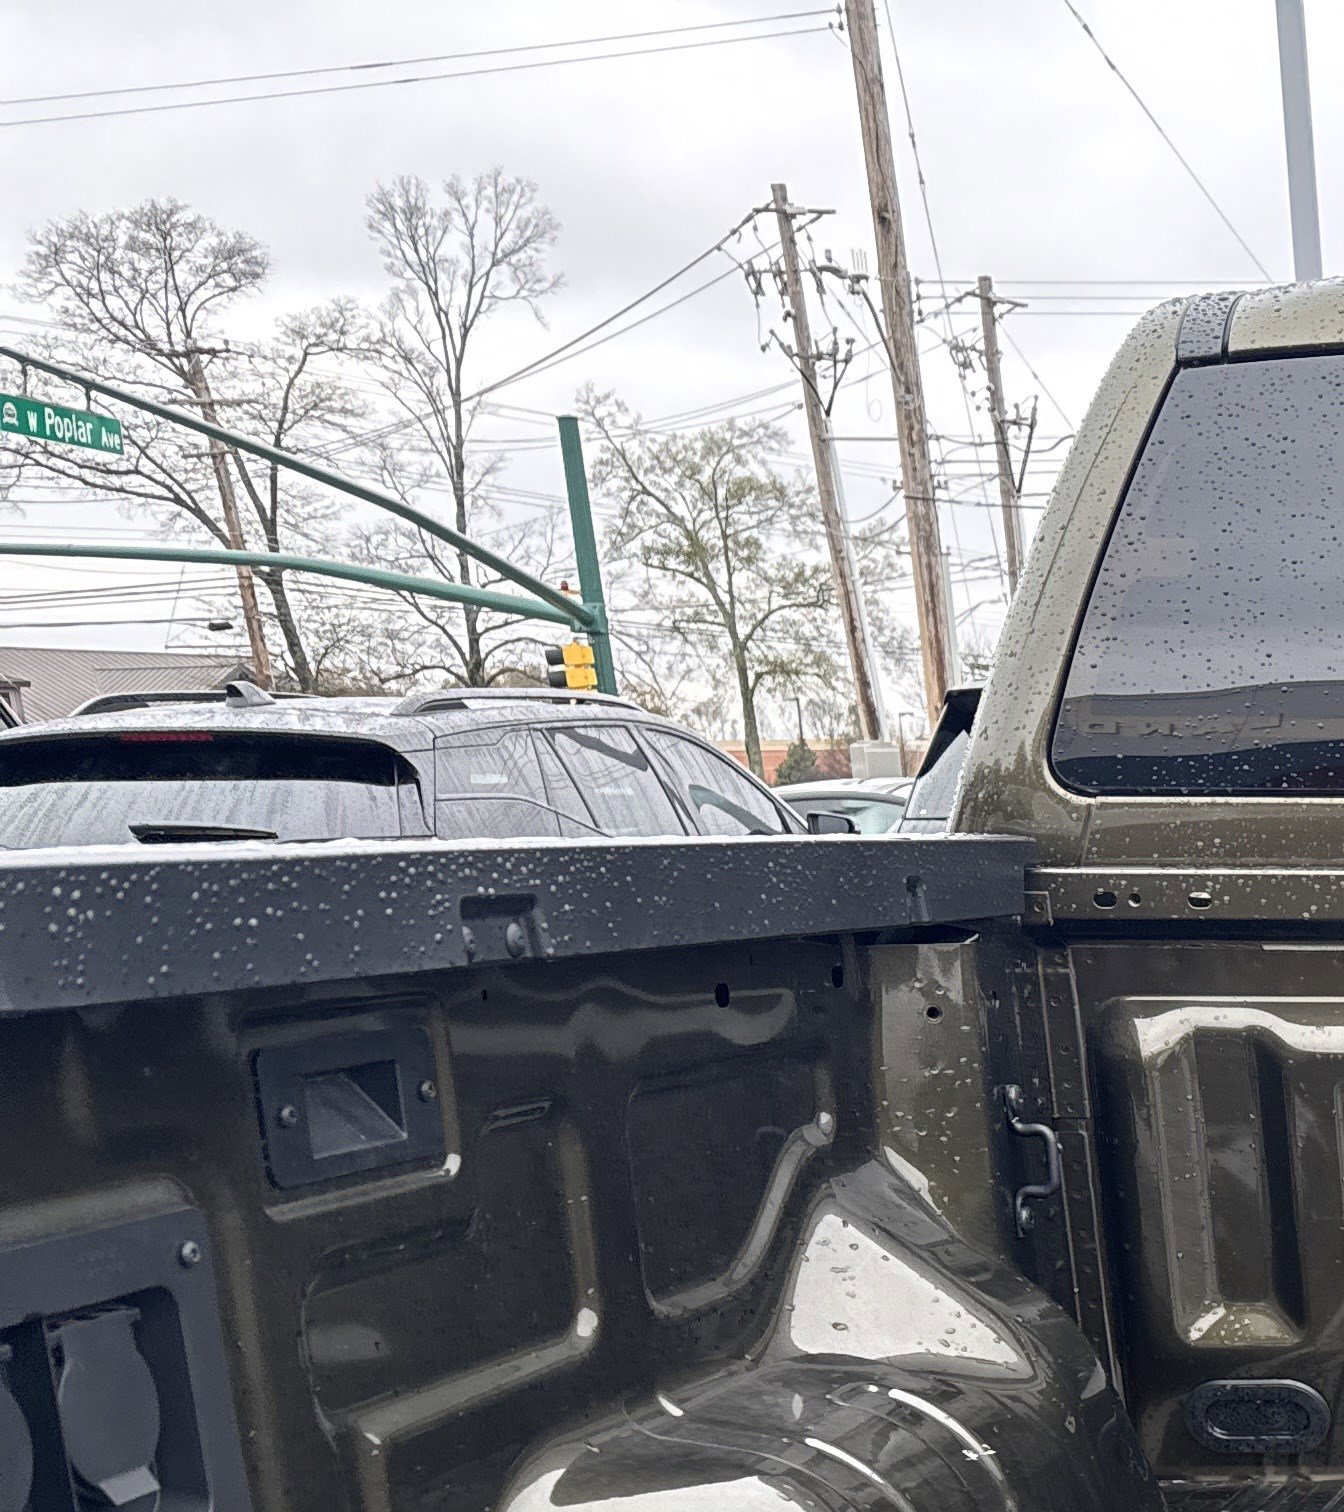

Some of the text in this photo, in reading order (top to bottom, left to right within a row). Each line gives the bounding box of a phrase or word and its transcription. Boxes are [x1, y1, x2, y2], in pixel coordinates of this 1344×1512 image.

[26, 406, 121, 450] W Poplar Ave
